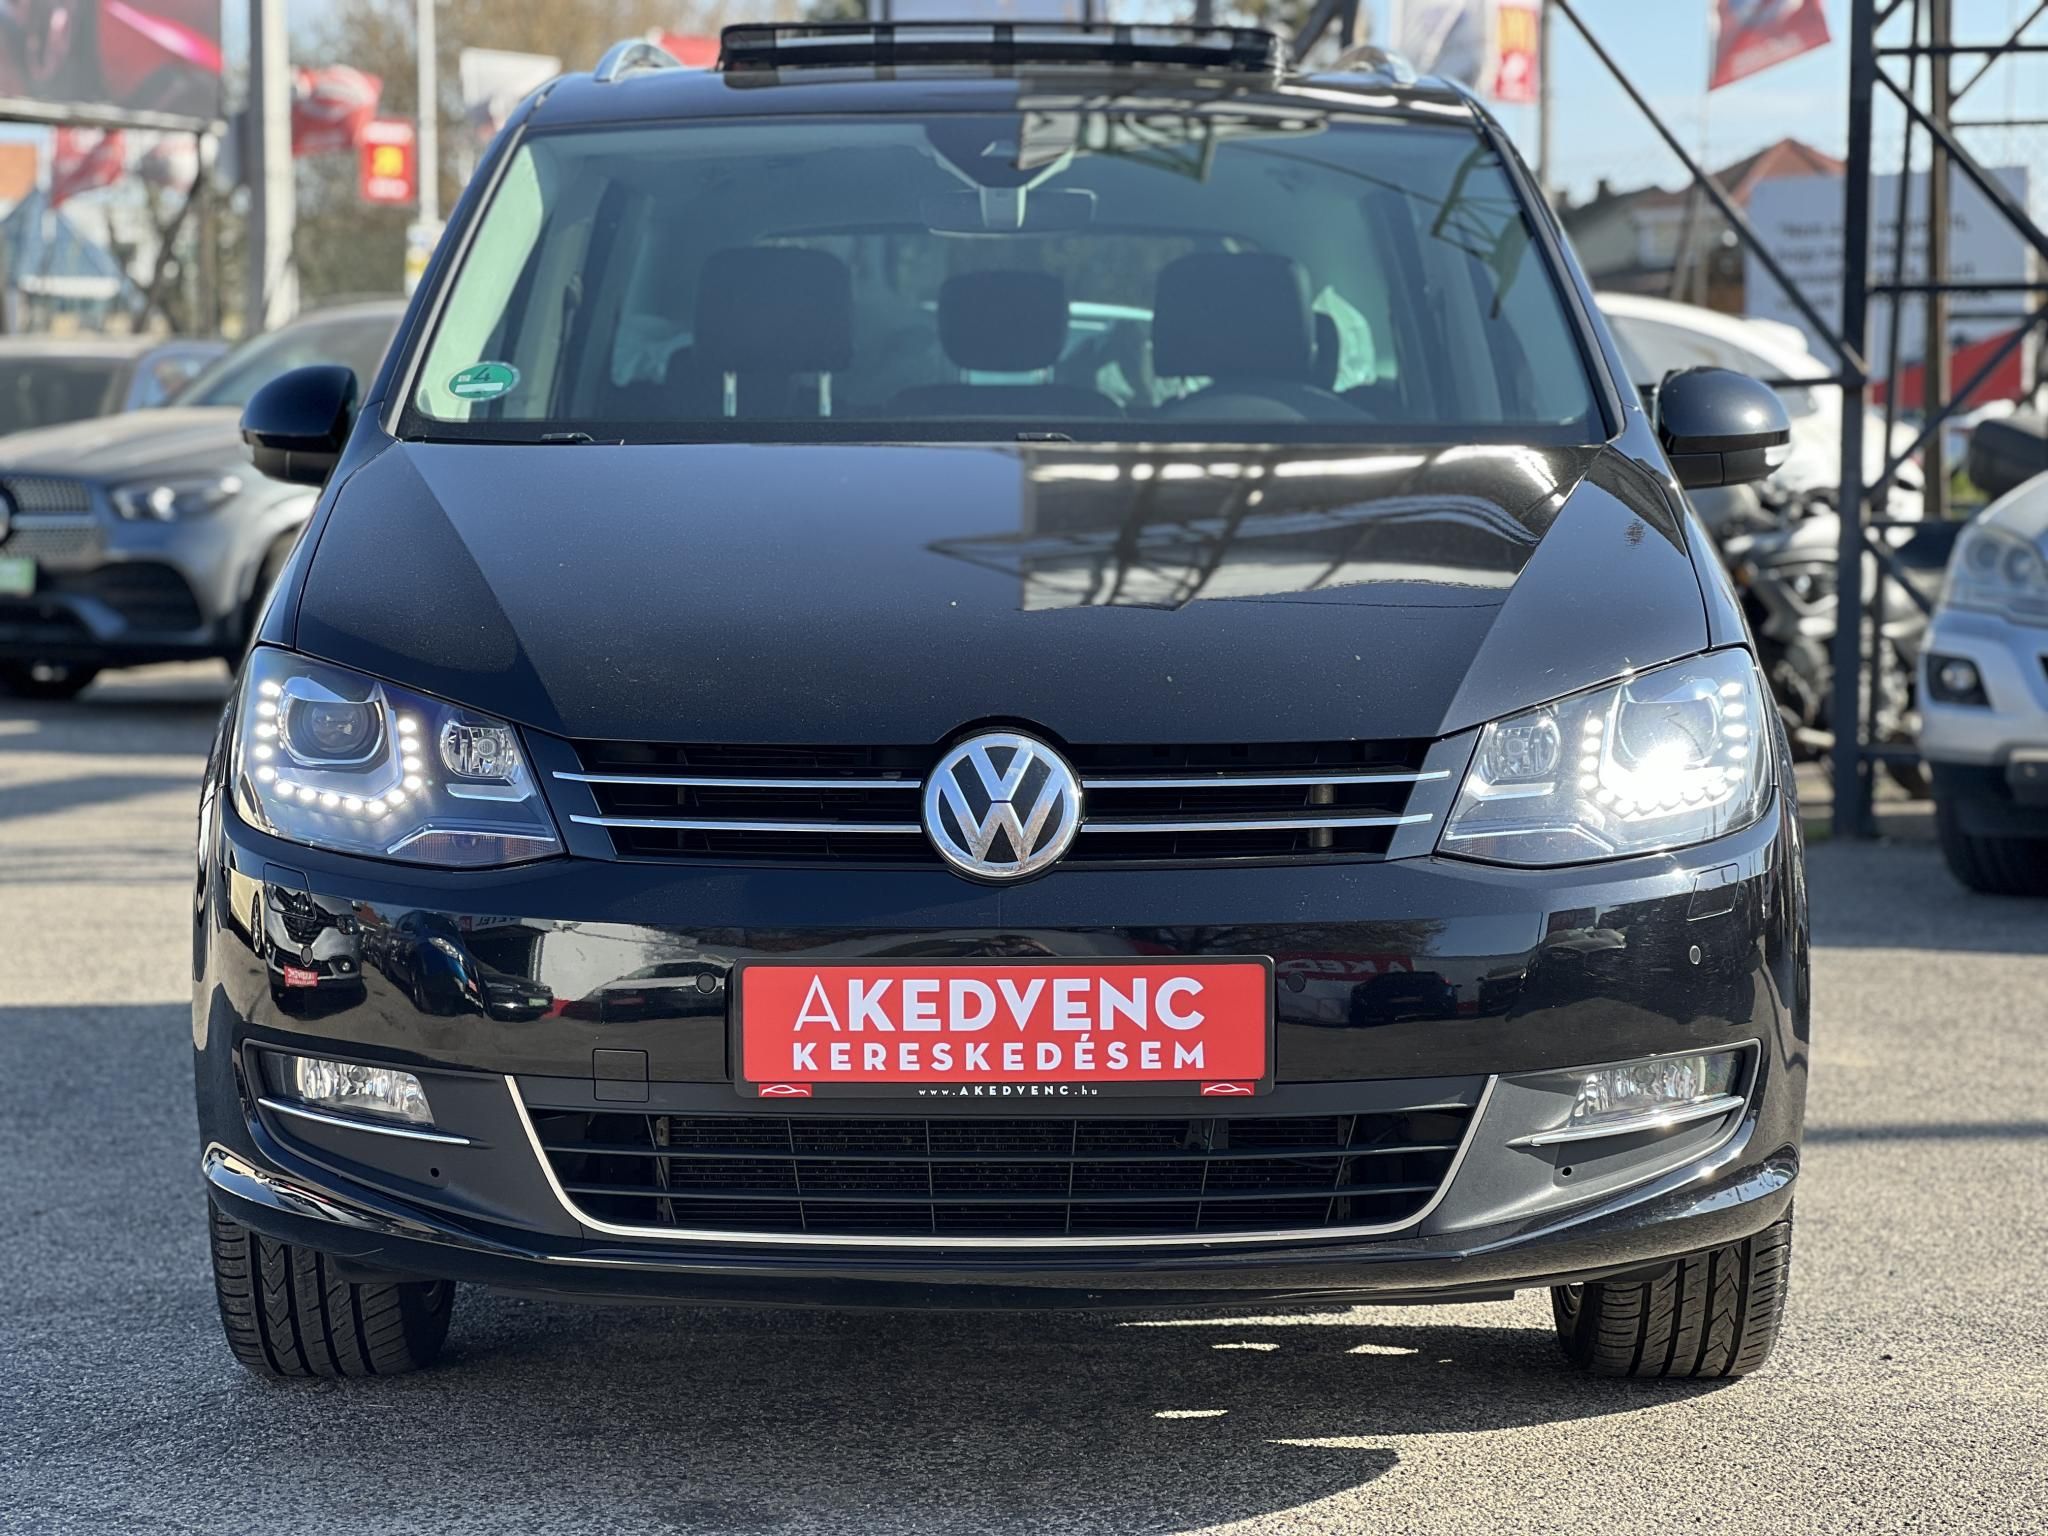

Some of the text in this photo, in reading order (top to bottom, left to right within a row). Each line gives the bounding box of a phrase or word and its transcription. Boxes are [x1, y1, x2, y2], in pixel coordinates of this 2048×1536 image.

[473, 367, 491, 382] 4
[929, 737, 1074, 871] VW
[793, 974, 1206, 1032] AKEDVENC
[792, 1033, 1205, 1072] KERESKEDÉSEM
[918, 1084, 1098, 1097] www.AKEDVENC.hu
